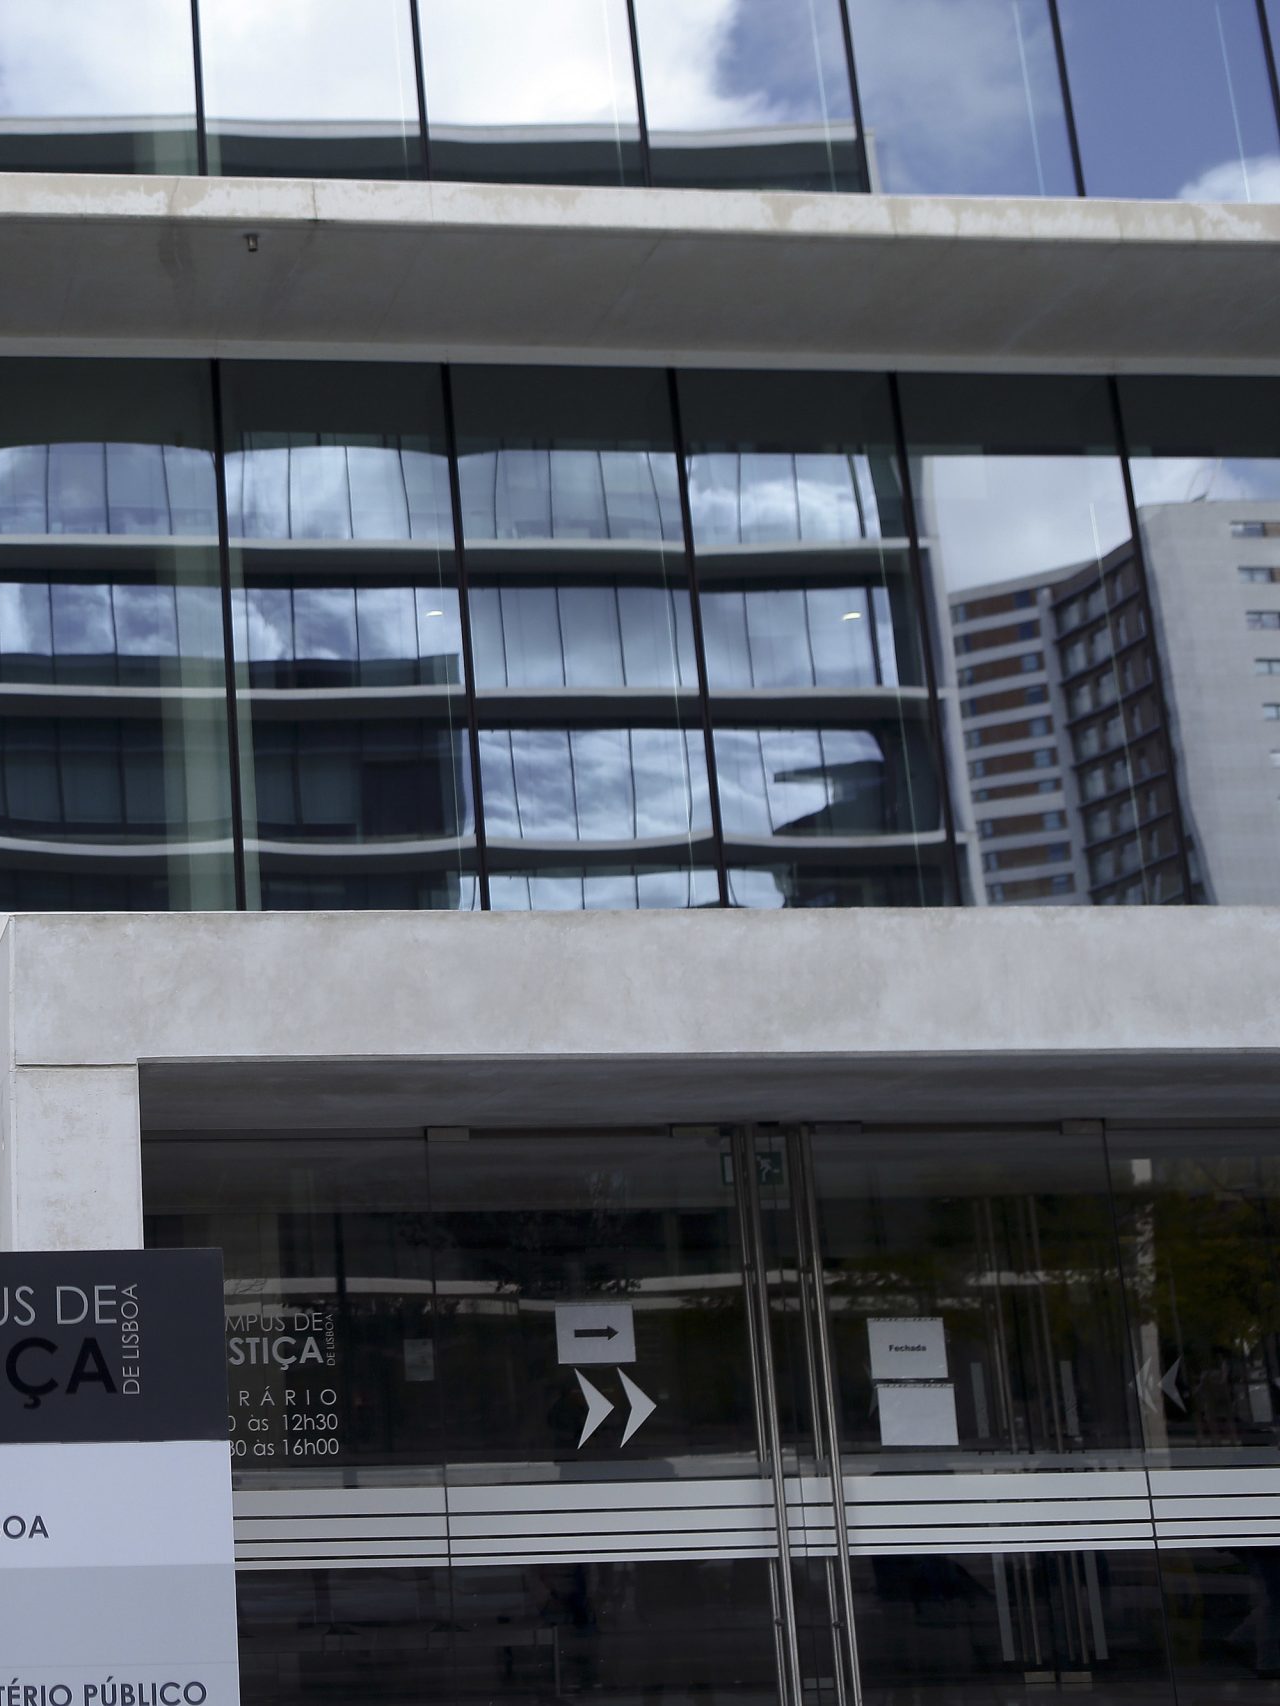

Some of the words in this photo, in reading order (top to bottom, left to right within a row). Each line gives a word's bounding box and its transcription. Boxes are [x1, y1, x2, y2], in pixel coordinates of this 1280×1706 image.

[55, 1284, 118, 1325] DE
[121, 1283, 139, 1359] LISBOA
[294, 1312, 324, 1331] DE
[324, 1313, 335, 1350] LISBOA
[326, 1352, 336, 1366] DE
[122, 1366, 140, 1395] DE
[227, 1386, 337, 1407] RÁRIO
[282, 1413, 338, 1431] 12h30
[282, 1438, 340, 1456] 16h00
[83, 1675, 207, 1706] PÚBLICO
